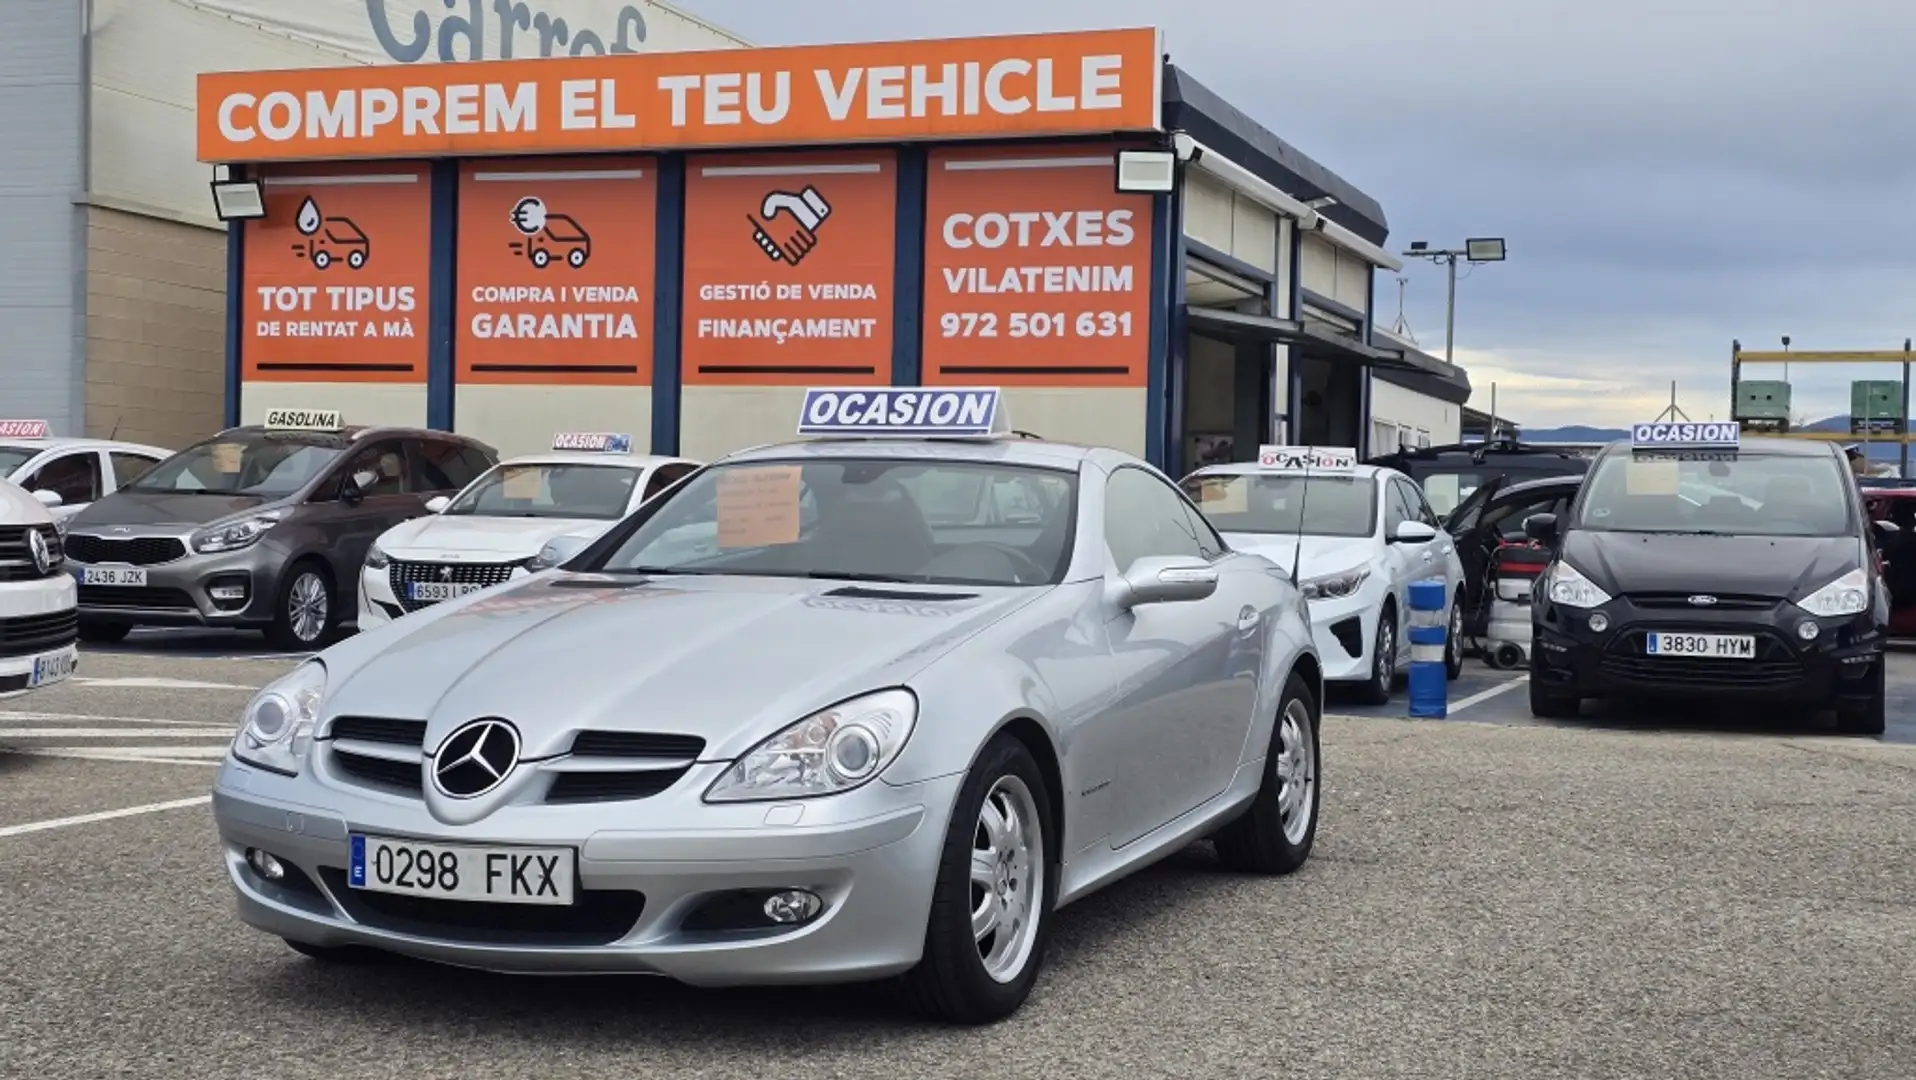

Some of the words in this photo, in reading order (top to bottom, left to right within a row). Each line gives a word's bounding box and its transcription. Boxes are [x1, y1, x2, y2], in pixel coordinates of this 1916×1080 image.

[217, 83, 538, 142] COMPREM
[561, 79, 636, 130] EL
[658, 71, 791, 126] TEU
[814, 54, 1122, 120] VEHICLE
[942, 209, 1134, 250] COTXES
[942, 264, 1134, 294] VILATENIM
[257, 286, 318, 312] TOT
[326, 285, 416, 312] TIPUS
[472, 286, 555, 303] COMPRA
[561, 287, 567, 302] I
[572, 286, 639, 304] VENDA
[700, 280, 771, 301] GESTIÓ
[776, 284, 803, 300] DE
[808, 283, 878, 300] VENDA
[257, 321, 281, 337] DE
[286, 321, 358, 337] RENTAT
[363, 321, 378, 337] A
[383, 317, 415, 338] MÀ
[471, 312, 638, 339] GARANTIA
[698, 317, 877, 345] FINANÇAMENT
[940, 312, 998, 338] 972
[1008, 312, 1066, 338] 501
[1075, 311, 1132, 338] 631
[268, 411, 335, 427] GASOLINA
[809, 392, 992, 425] OCASION
[555, 434, 606, 450] OCASION
[1636, 424, 1736, 441] OCASION
[1261, 453, 1349, 469] OCASION
[87, 570, 116, 583] 2436
[119, 570, 143, 583] JZK
[416, 585, 449, 599] 6593
[1663, 635, 1708, 653] 3830
[1716, 638, 1751, 655] HYM
[376, 844, 460, 891] 0298
[486, 853, 559, 896] FKX
